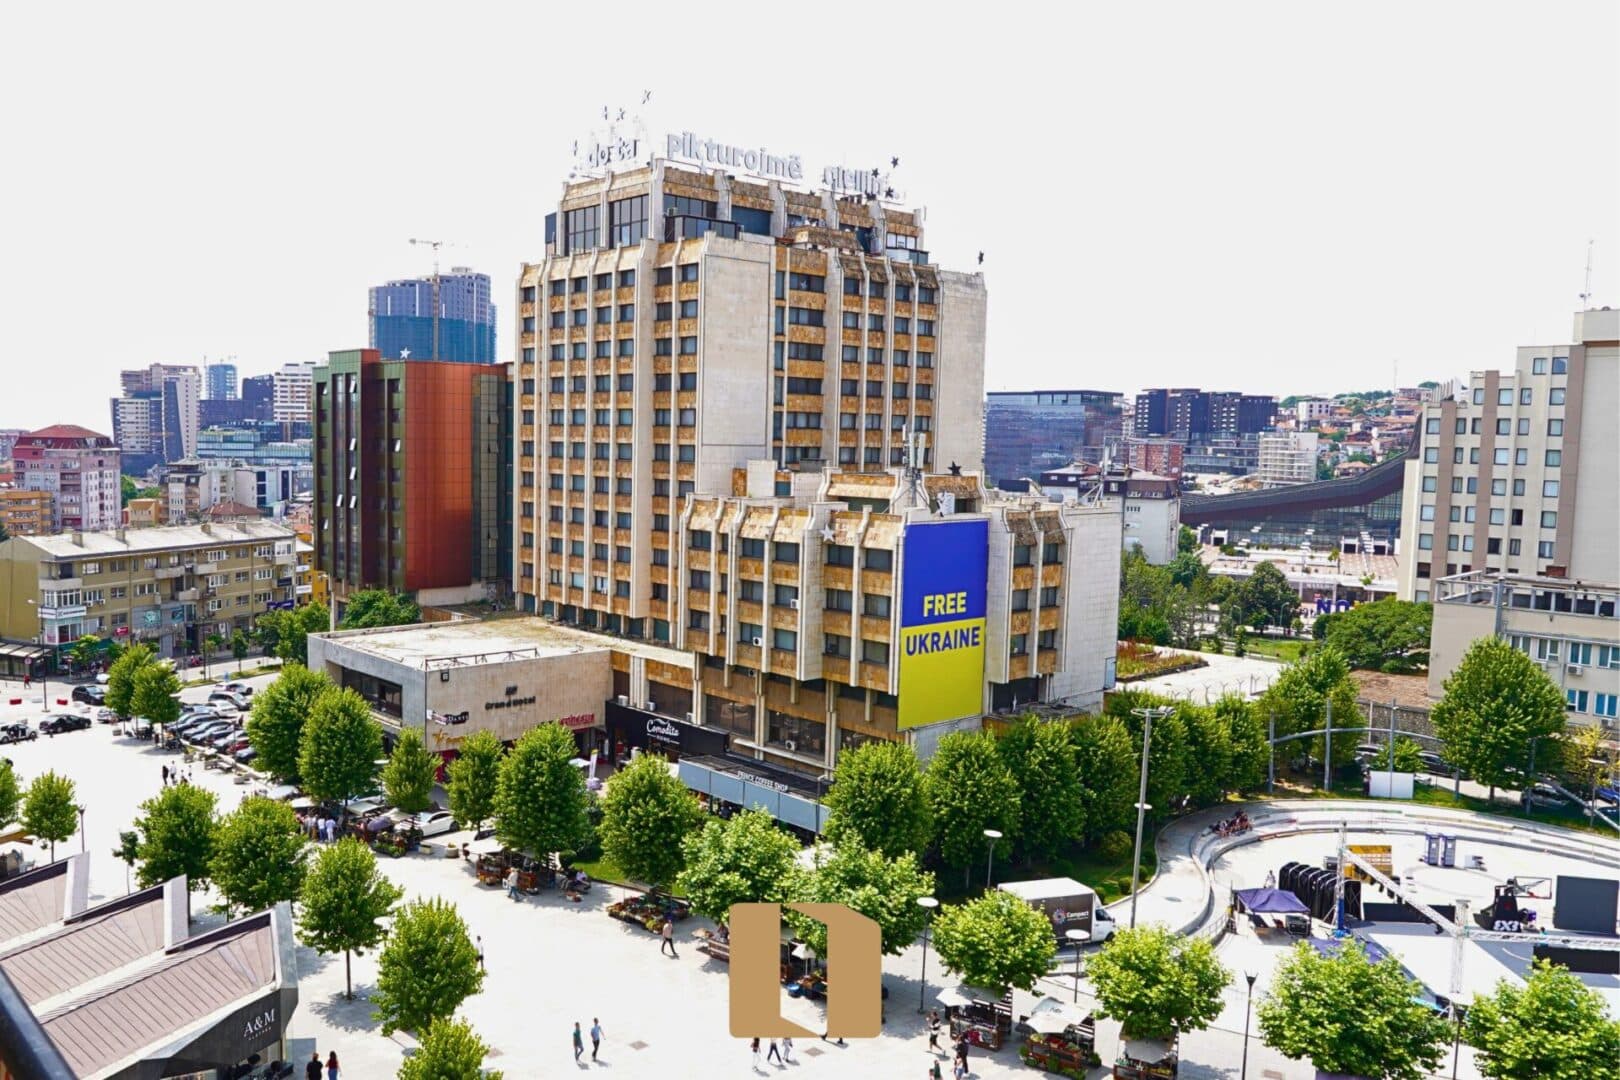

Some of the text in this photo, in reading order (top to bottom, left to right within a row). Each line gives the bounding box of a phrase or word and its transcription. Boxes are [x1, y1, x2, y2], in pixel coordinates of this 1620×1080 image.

[666, 131, 803, 179] pikturojmë
[923, 592, 967, 617] FREE
[906, 626, 980, 656] UKRAINE
[774, 782, 788, 792] SHOP
[243, 1008, 275, 1038] A&M
